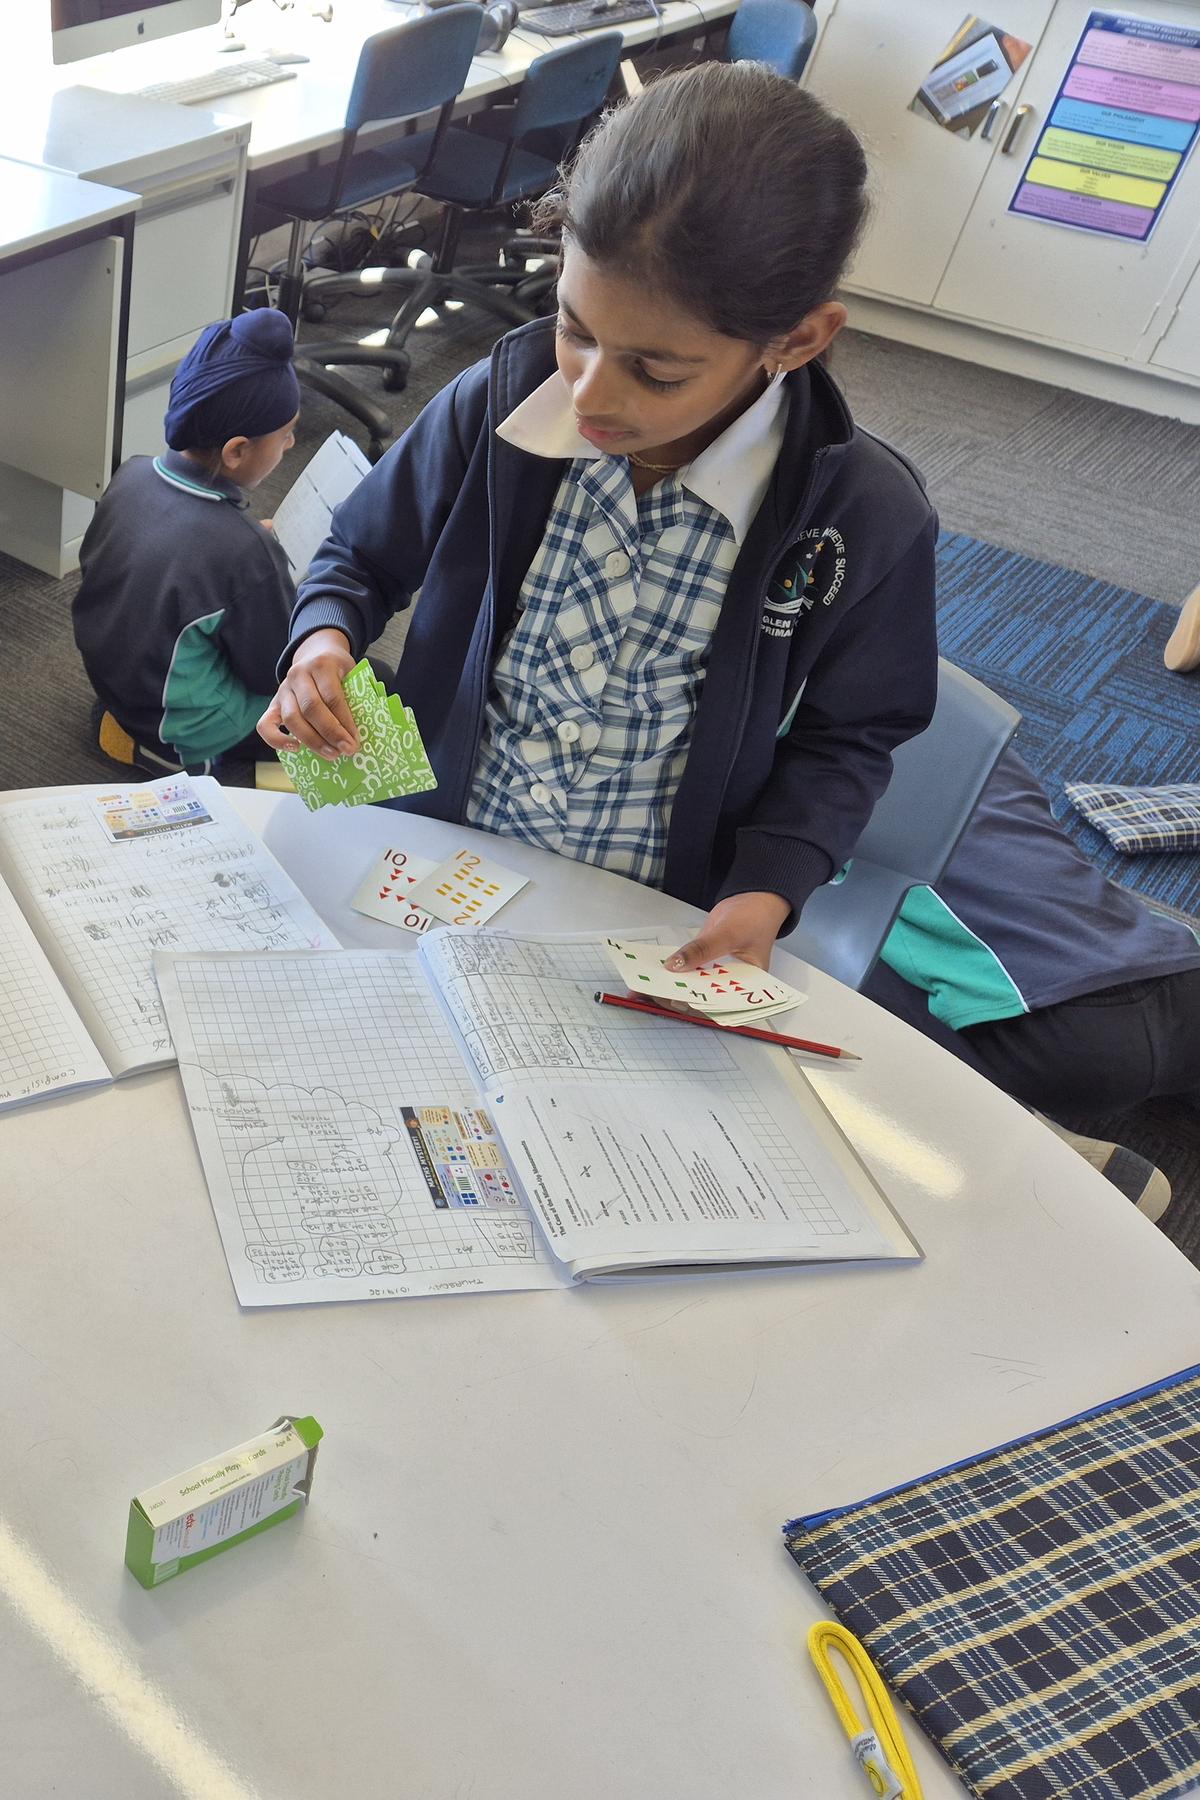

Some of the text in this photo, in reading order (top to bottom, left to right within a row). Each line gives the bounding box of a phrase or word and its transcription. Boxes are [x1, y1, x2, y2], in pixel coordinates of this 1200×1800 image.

[823, 557, 846, 606] SUCCEED
[763, 615, 791, 628] GLEN
[384, 848, 408, 866] 10
[455, 850, 482, 869] 12
[404, 913, 429, 931] 10
[607, 938, 623, 950] 4
[689, 989, 709, 1002] 4
[740, 989, 776, 1004] 12
[520, 1140, 539, 1173] Measurements
[534, 1173, 550, 1197] Mixed-Up
[545, 1198, 553, 1206] the
[552, 1213, 562, 1225] Case
[557, 1225, 567, 1235] The
[177, 1480, 203, 1497] School
[199, 1469, 227, 1486] Friendly
[274, 1438, 287, 1449] Age
